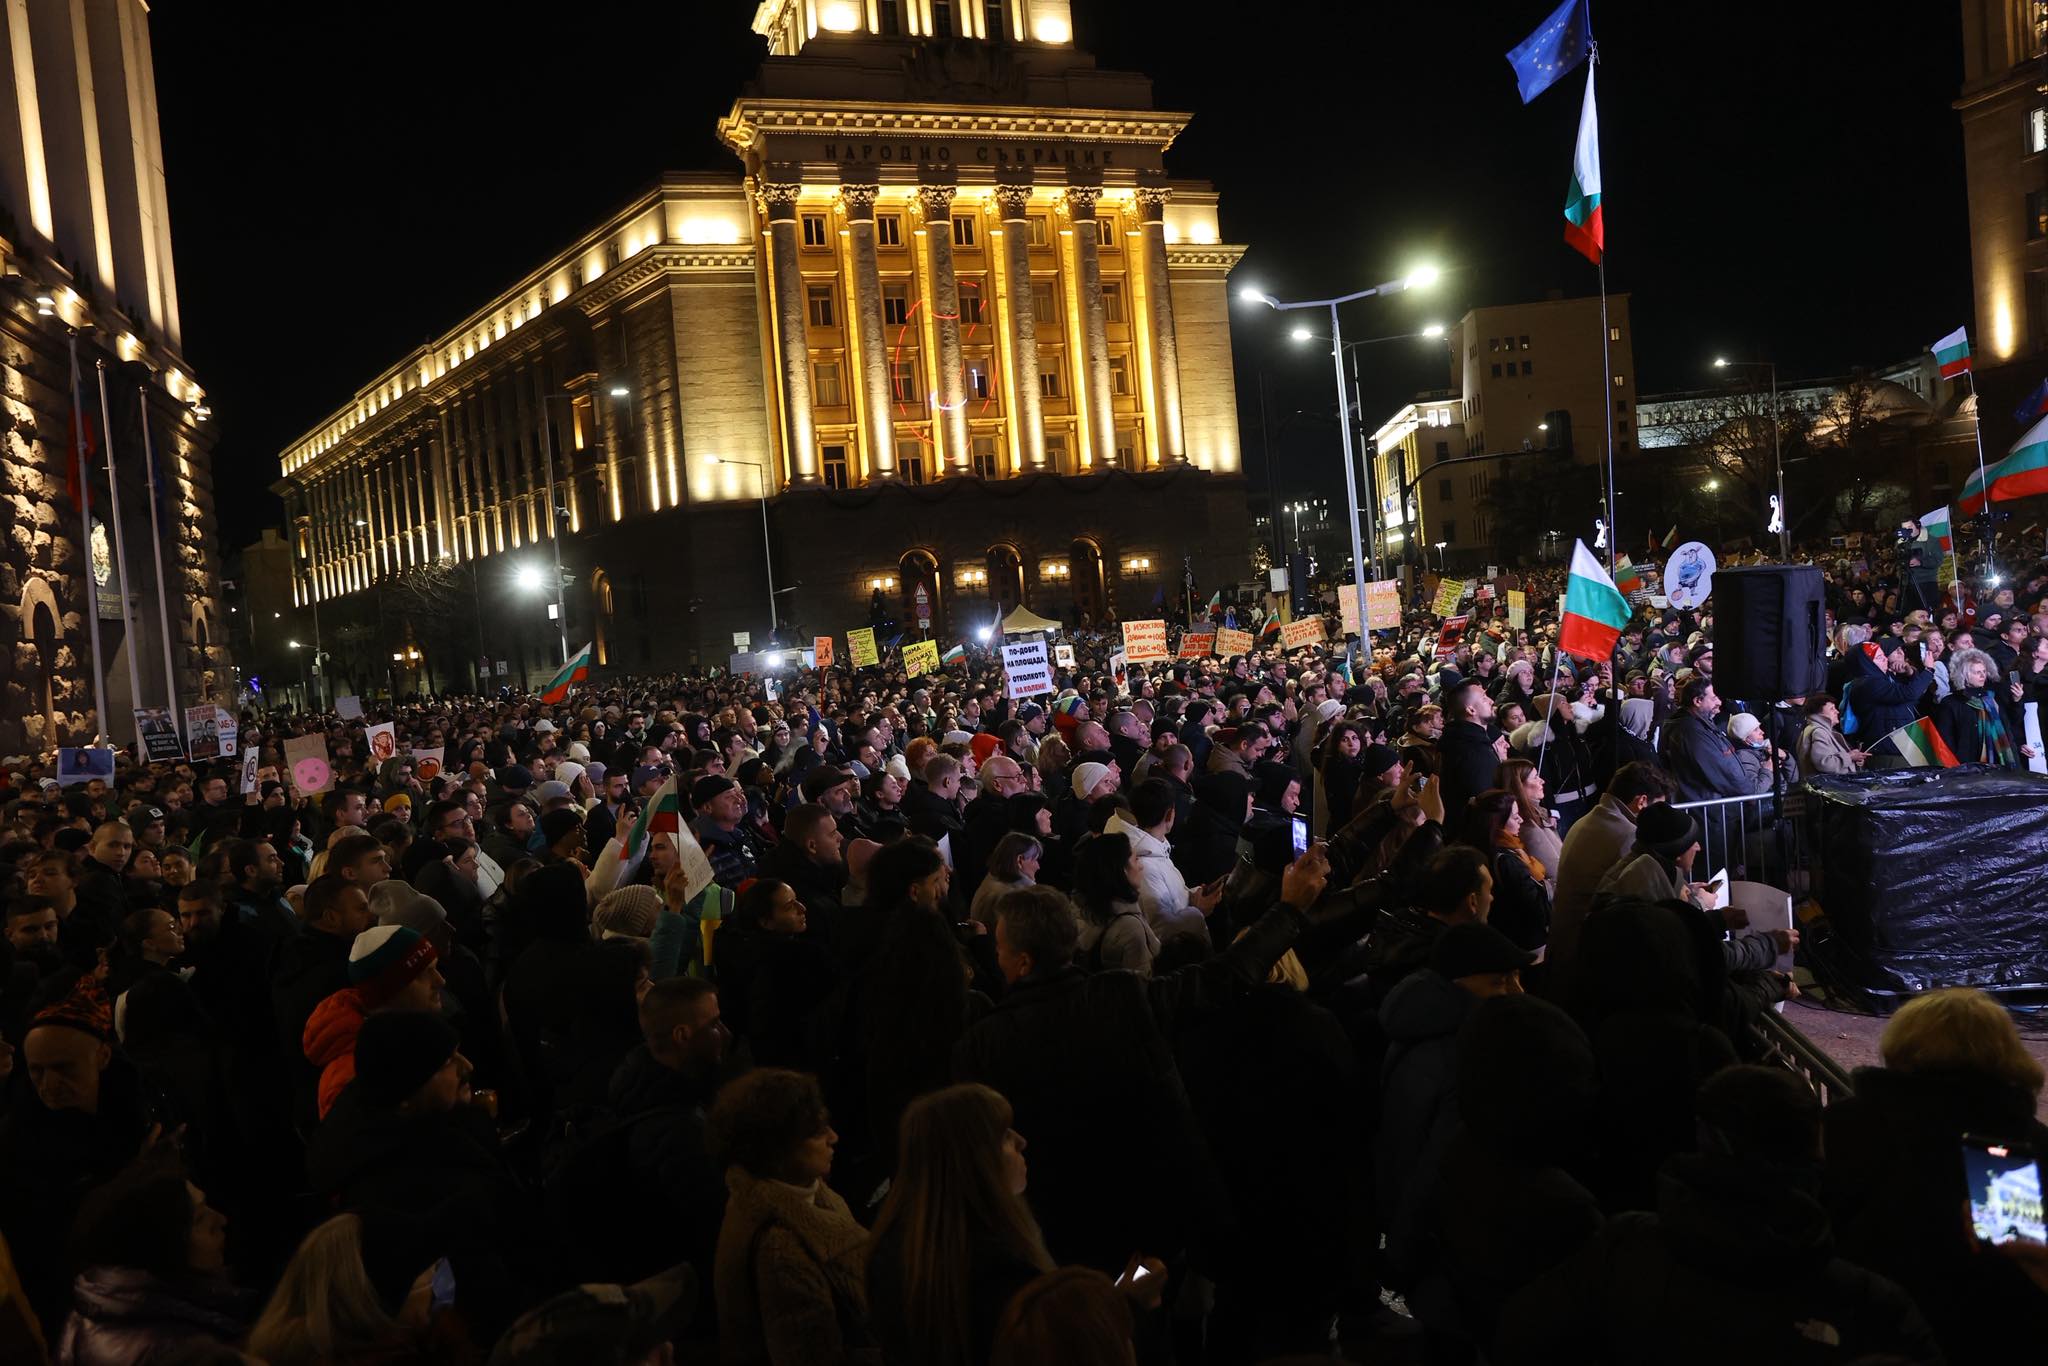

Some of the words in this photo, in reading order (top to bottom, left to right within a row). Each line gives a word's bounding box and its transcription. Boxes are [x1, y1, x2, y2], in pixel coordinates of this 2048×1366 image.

[824, 143, 952, 162] НАРОДНО
[976, 146, 1115, 165] СЪБРАНИЕ
[1124, 623, 1131, 634] В
[903, 645, 922, 657] НЯМА
[1008, 645, 1040, 656] ПО-ДОБРЕ
[1126, 645, 1136, 655] ОТ
[1137, 644, 1150, 653] ВАС
[1006, 659, 1015, 668] НА
[1015, 656, 1047, 667] ПЛОЩАДА,
[908, 662, 921, 675] STOP
[1012, 671, 1046, 683] ОТКОЛКОТО
[1015, 686, 1024, 694] НА
[1023, 682, 1048, 693] КОЛЕНЕ!
